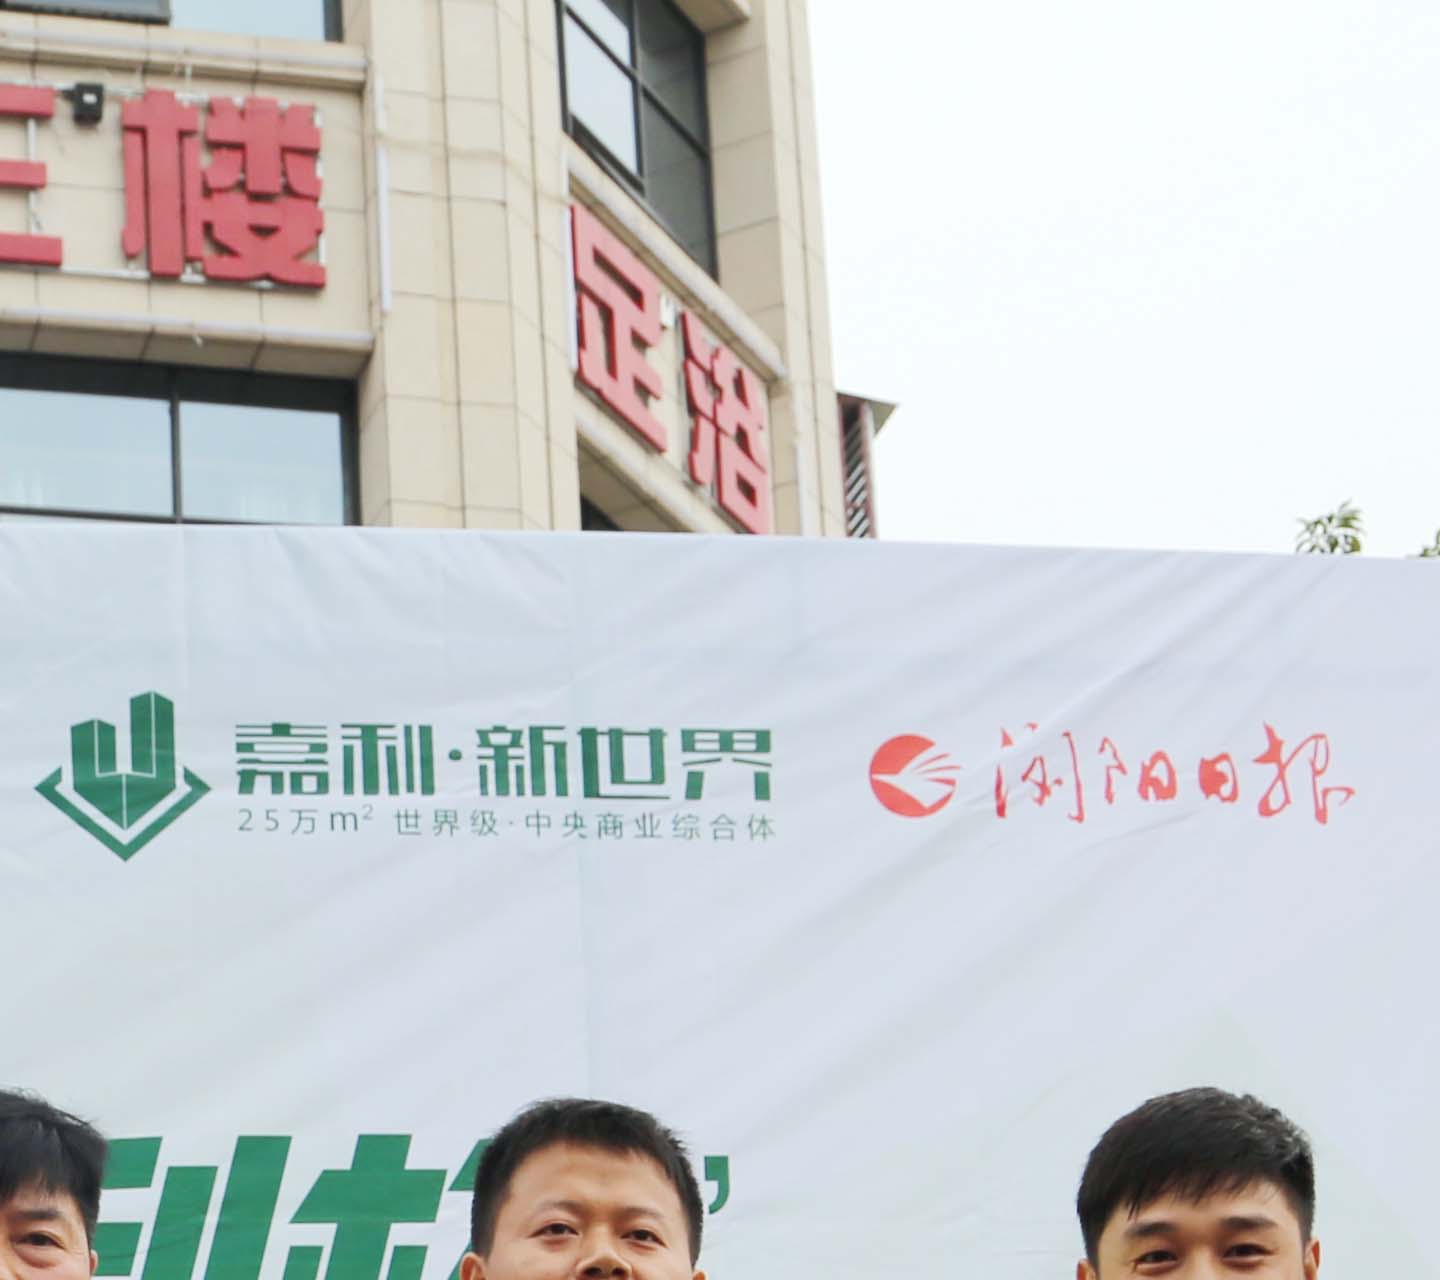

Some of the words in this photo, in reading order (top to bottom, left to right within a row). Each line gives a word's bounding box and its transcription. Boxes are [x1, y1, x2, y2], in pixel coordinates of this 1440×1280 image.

[235, 721, 776, 801] 嘉利·新世界
